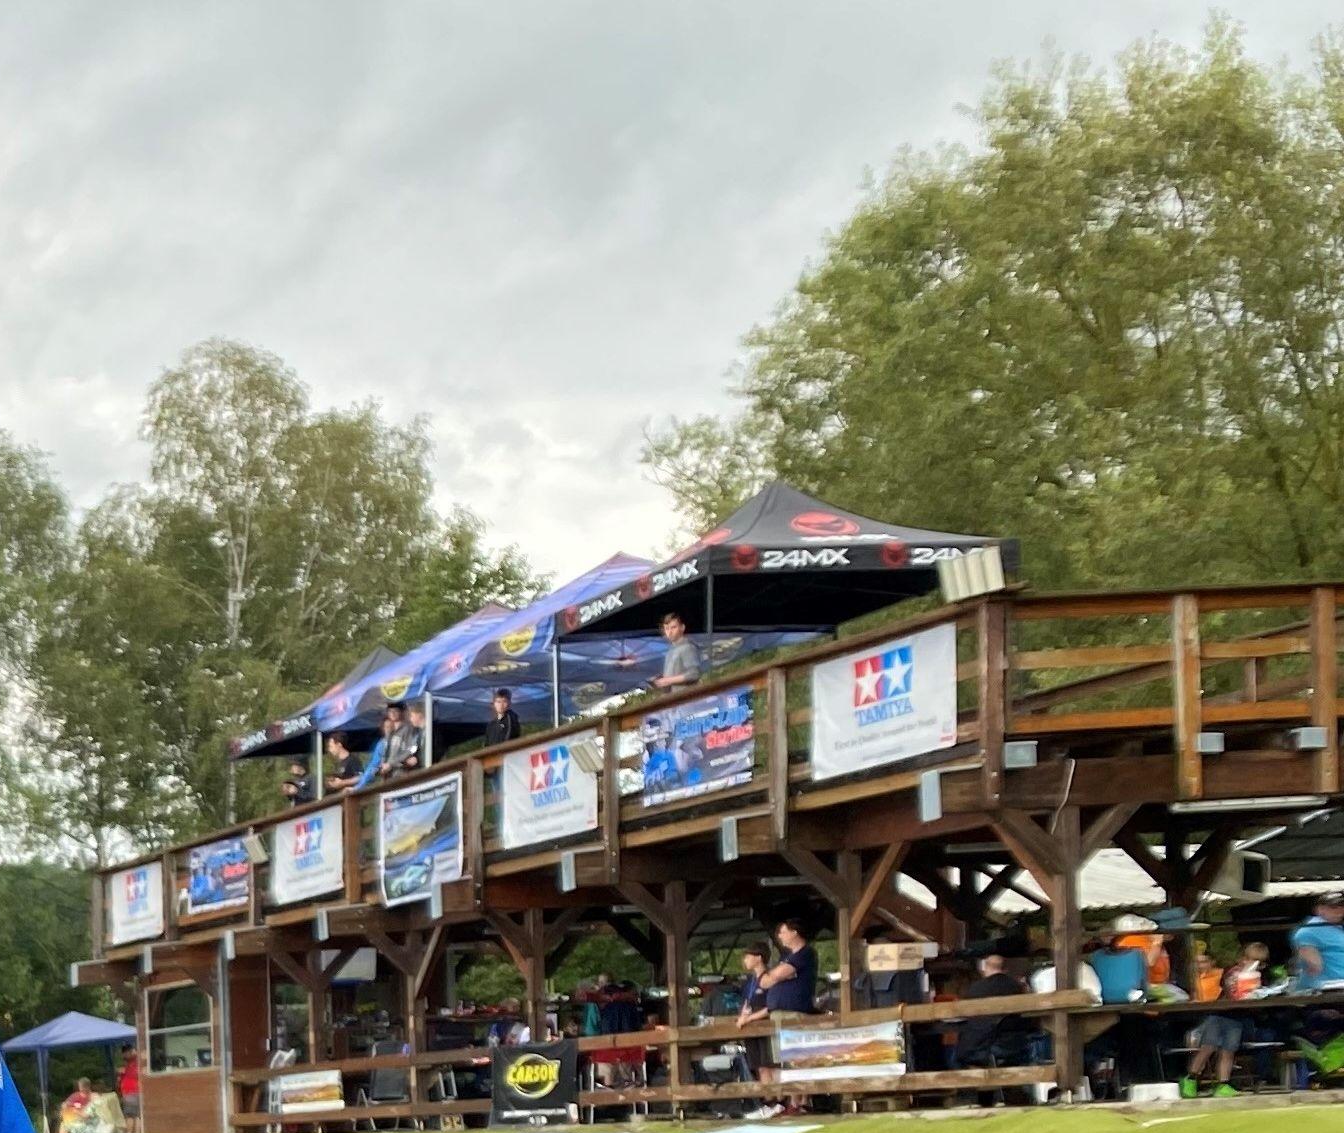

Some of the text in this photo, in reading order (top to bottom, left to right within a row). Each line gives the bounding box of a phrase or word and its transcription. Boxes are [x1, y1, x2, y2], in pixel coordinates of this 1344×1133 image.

[762, 547, 851, 570] 24MX
[652, 558, 699, 592] 24MX
[579, 590, 623, 624] 24MX
[855, 697, 914, 727] TAMIYA
[508, 1060, 559, 1084] CARSON
